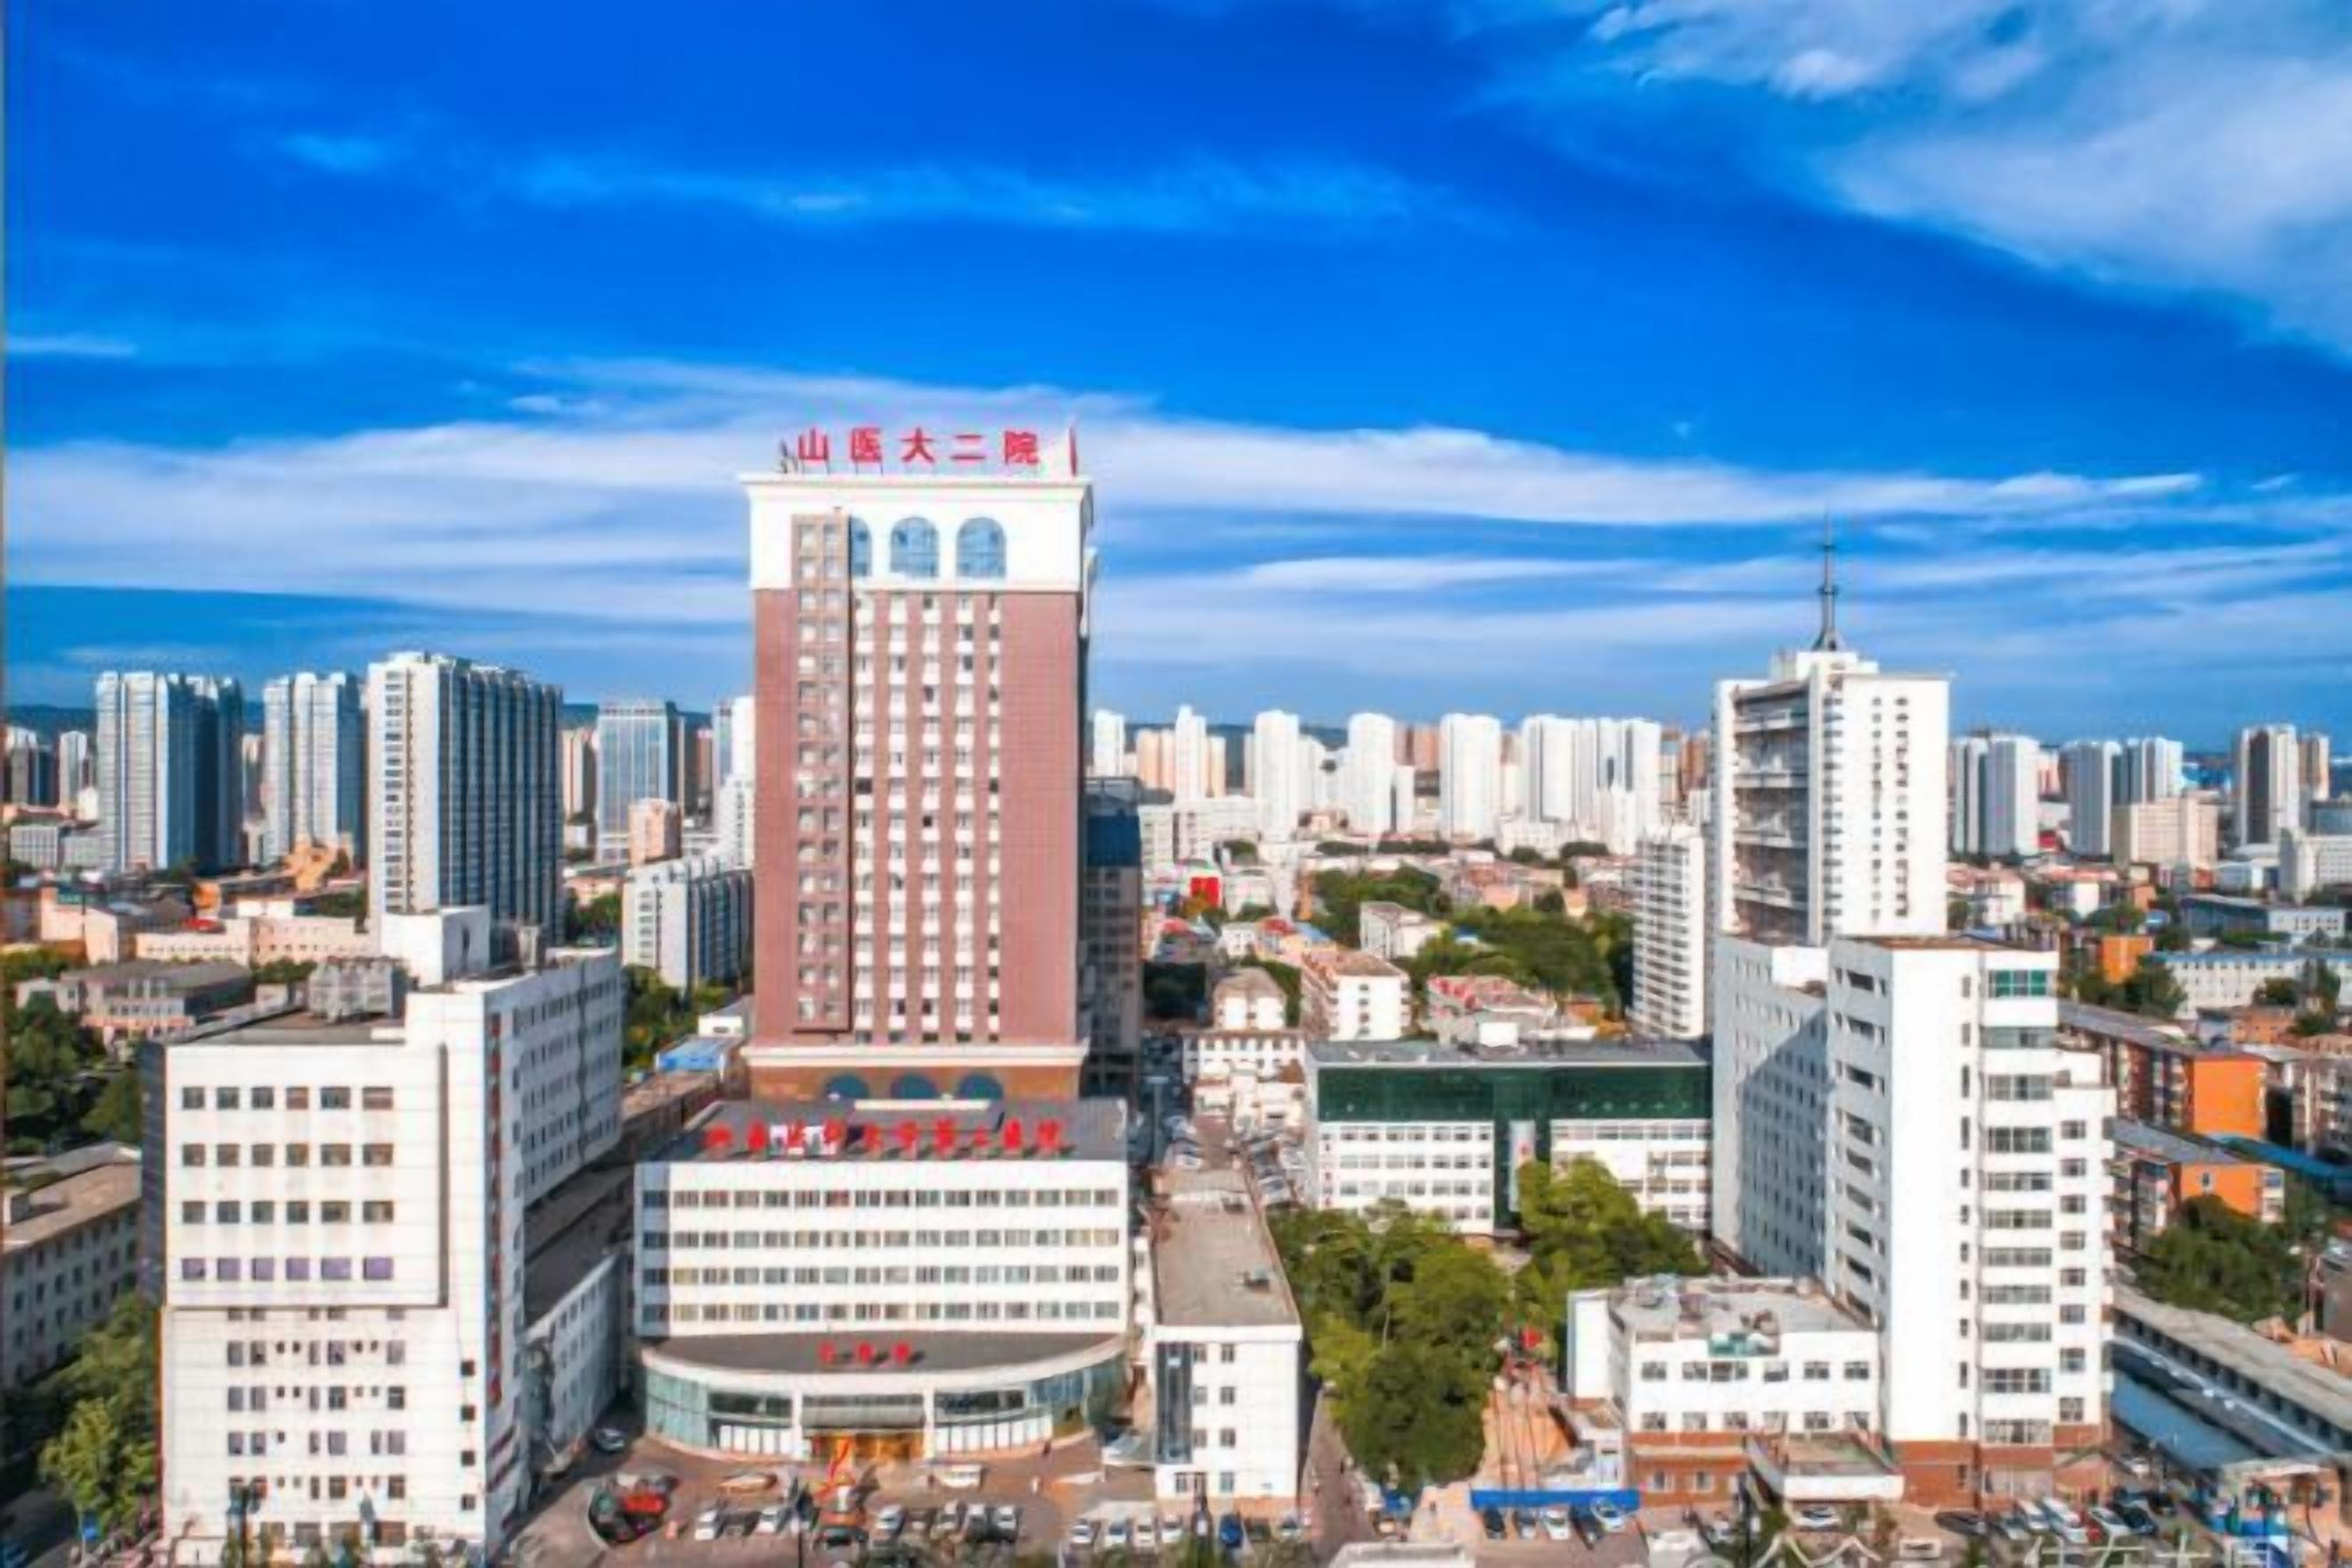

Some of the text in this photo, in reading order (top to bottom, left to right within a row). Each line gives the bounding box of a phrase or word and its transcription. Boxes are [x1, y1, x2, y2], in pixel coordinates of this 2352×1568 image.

[798, 427, 1041, 464] 山医大二院
